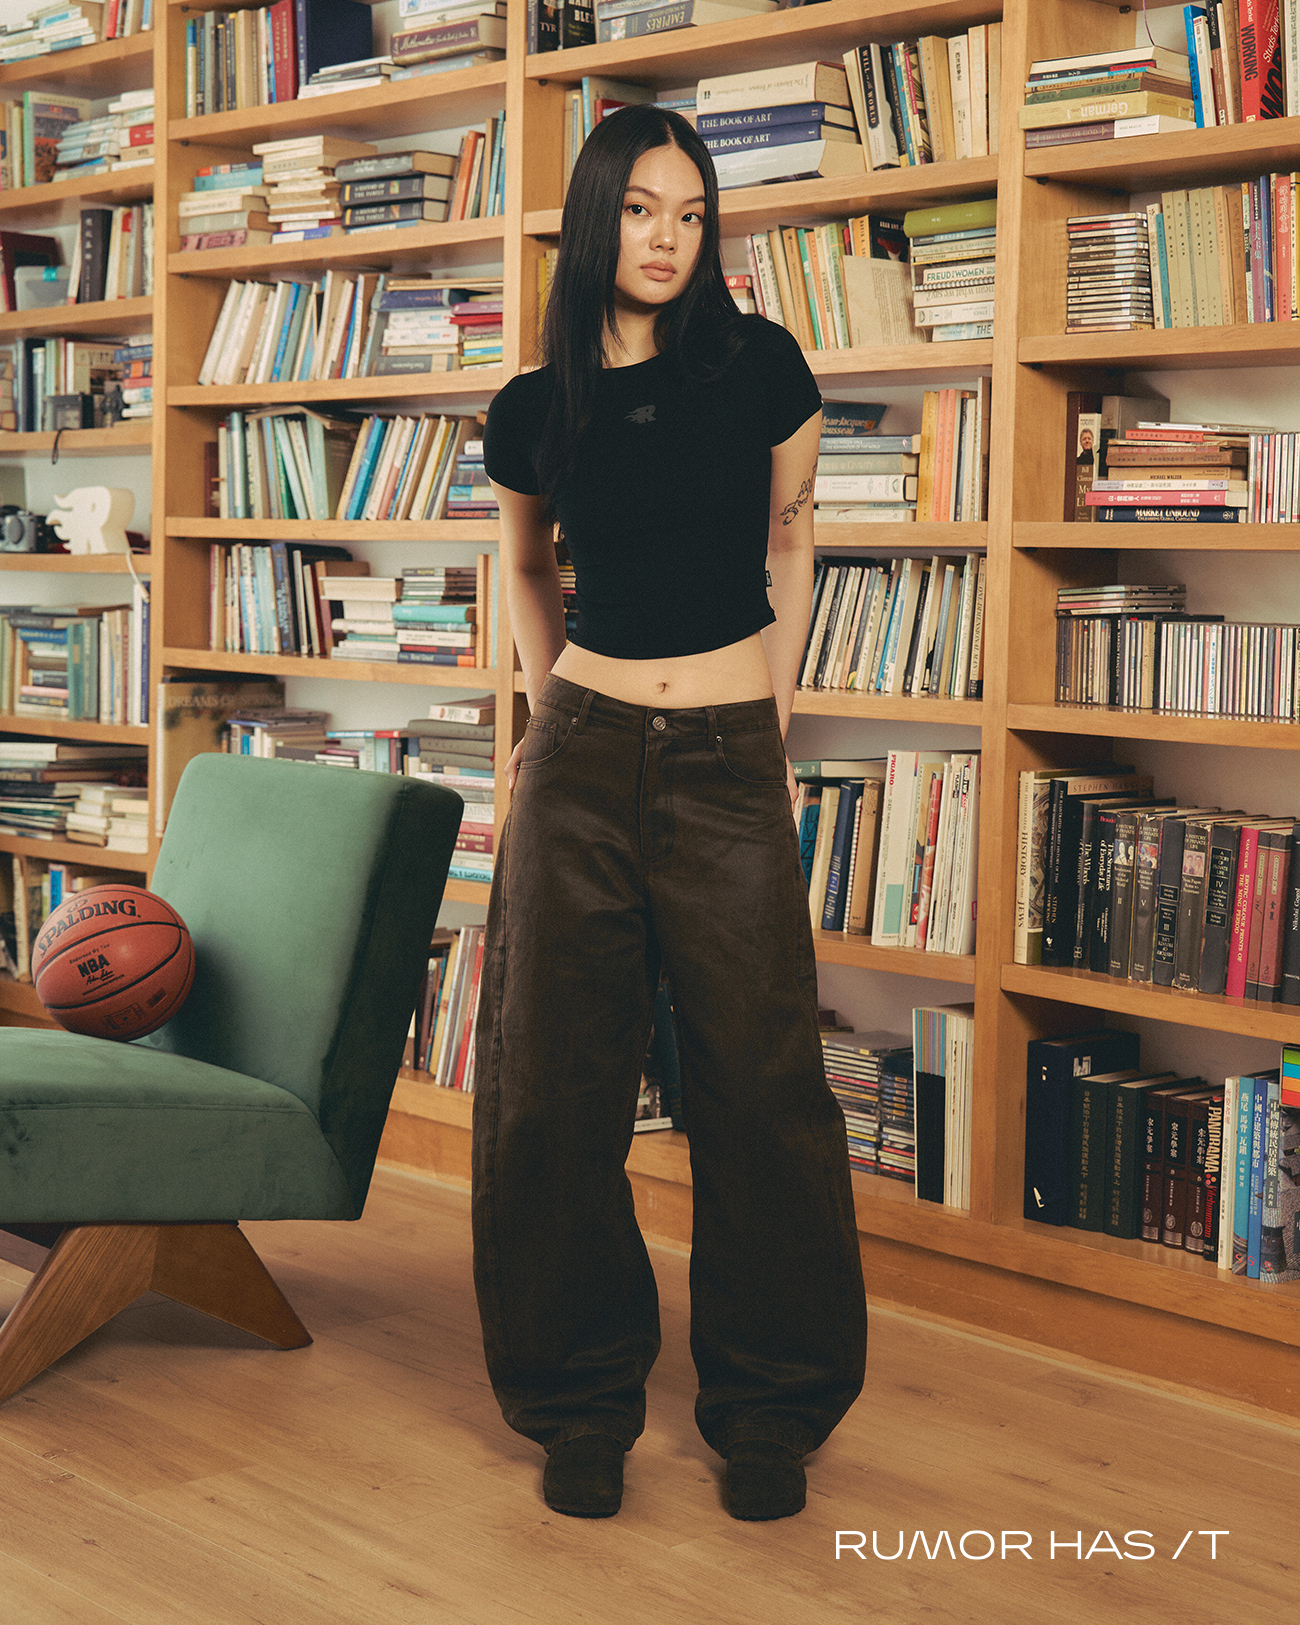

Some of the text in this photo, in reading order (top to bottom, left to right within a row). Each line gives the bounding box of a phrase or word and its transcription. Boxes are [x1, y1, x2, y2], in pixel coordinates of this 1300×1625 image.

[646, 10, 684, 32] EMPIRES
[1246, 6, 1254, 22] Terkel
[1240, 24, 1258, 82] WORKING
[1263, 35, 1276, 62] Studs
[861, 49, 870, 73] WILL
[866, 91, 876, 124] WORLD
[889, 69, 899, 106] DEMOCRACY
[701, 120, 718, 128] THE
[720, 118, 742, 127] BOOK
[755, 113, 772, 122] ART
[1081, 102, 1128, 118] German
[703, 134, 770, 149] THE BOOK OF ART
[1042, 128, 1098, 141] THE LAW OF GOD
[926, 268, 984, 281] FREUD WOMEN
[927, 290, 943, 302] say?
[958, 287, 974, 298] what
[976, 325, 992, 334] THE
[1135, 509, 1200, 517] MARKET UNBOUND
[1072, 781, 1109, 793] STEPHEN
[1019, 832, 1027, 877] HISTORY
[1083, 842, 1092, 885] The Wheels
[1096, 839, 1107, 891] of Everyday Life
[1103, 842, 1114, 891] The Structures
[1016, 900, 1024, 927] JEWS
[1292, 907, 1300, 930] Nikolai
[38, 899, 136, 958] SPALDING
[70, 952, 91, 964] Endorsed
[77, 954, 110, 977] NBA
[1237, 953, 1242, 962] OF
[1204, 1106, 1222, 1173] PANORAMA
